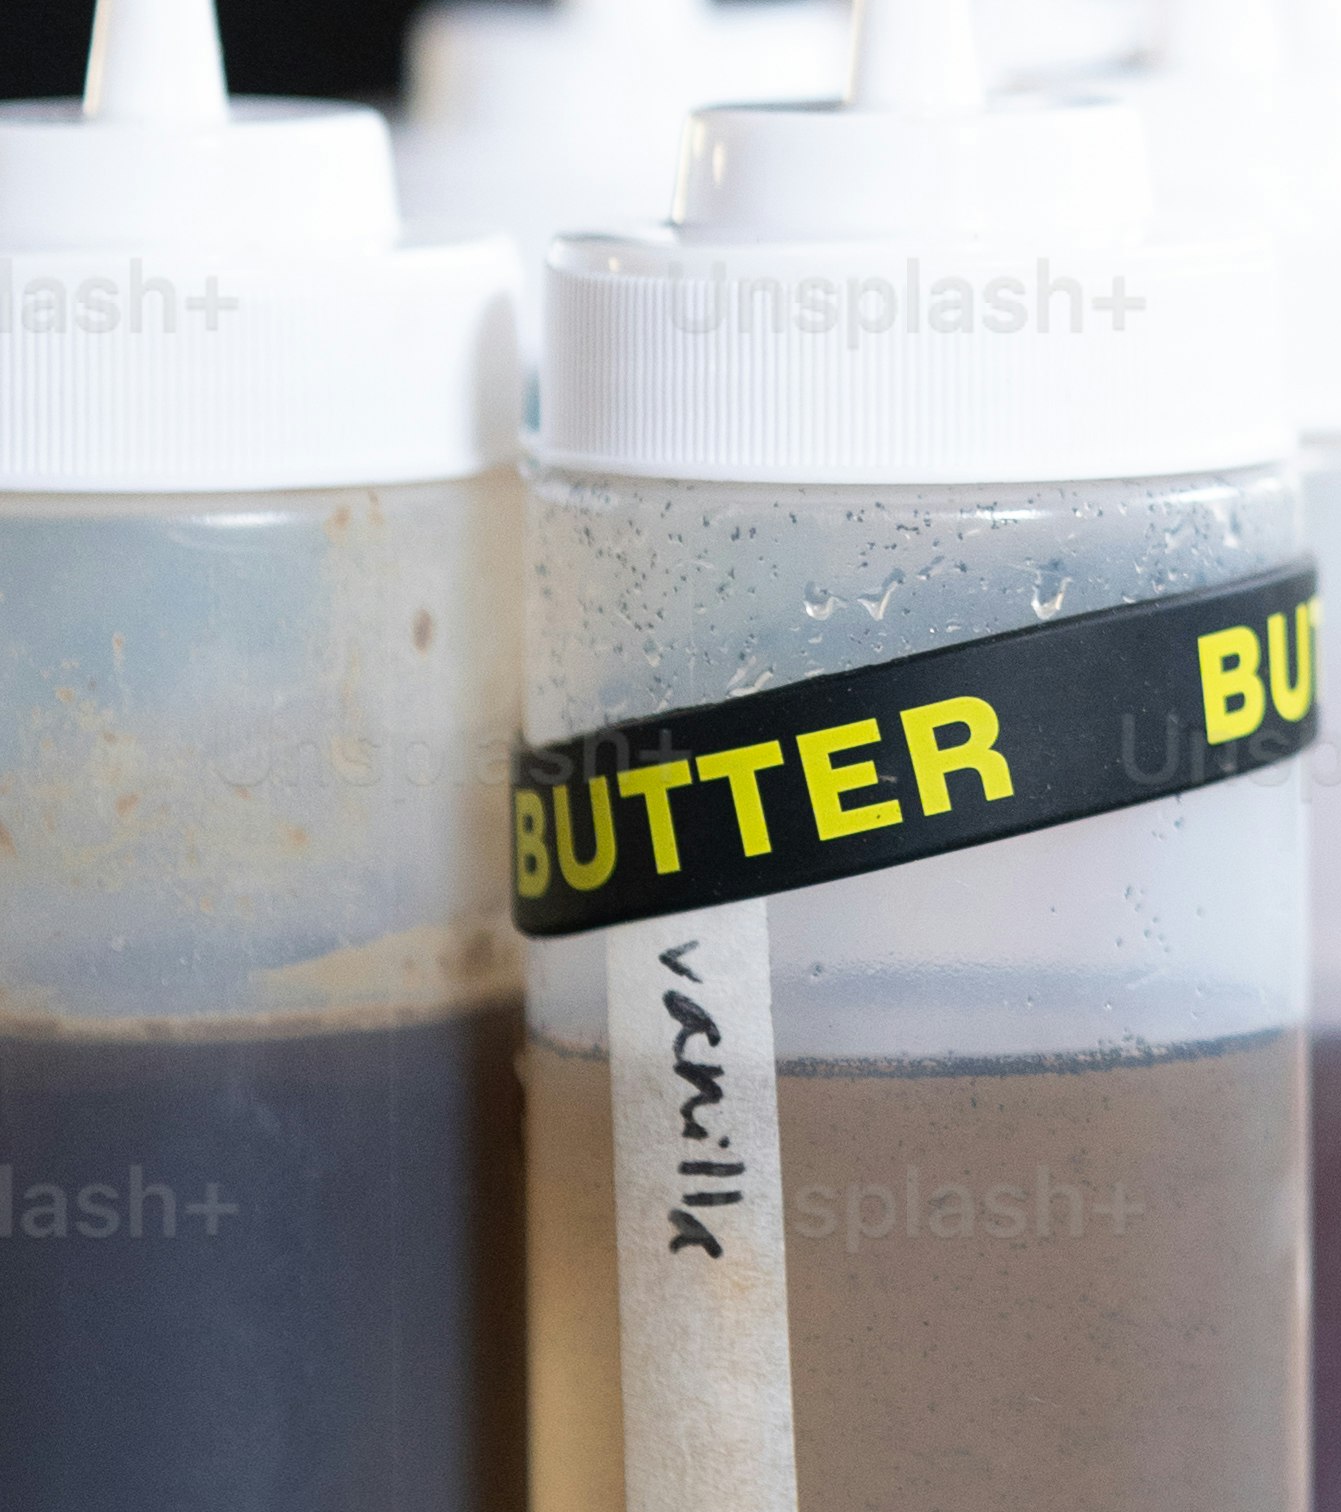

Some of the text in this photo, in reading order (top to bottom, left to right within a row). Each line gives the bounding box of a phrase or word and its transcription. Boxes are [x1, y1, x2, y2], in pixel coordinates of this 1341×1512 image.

[515, 597, 1325, 898] BUTTER BU
[659, 940, 746, 1259] vanilla
